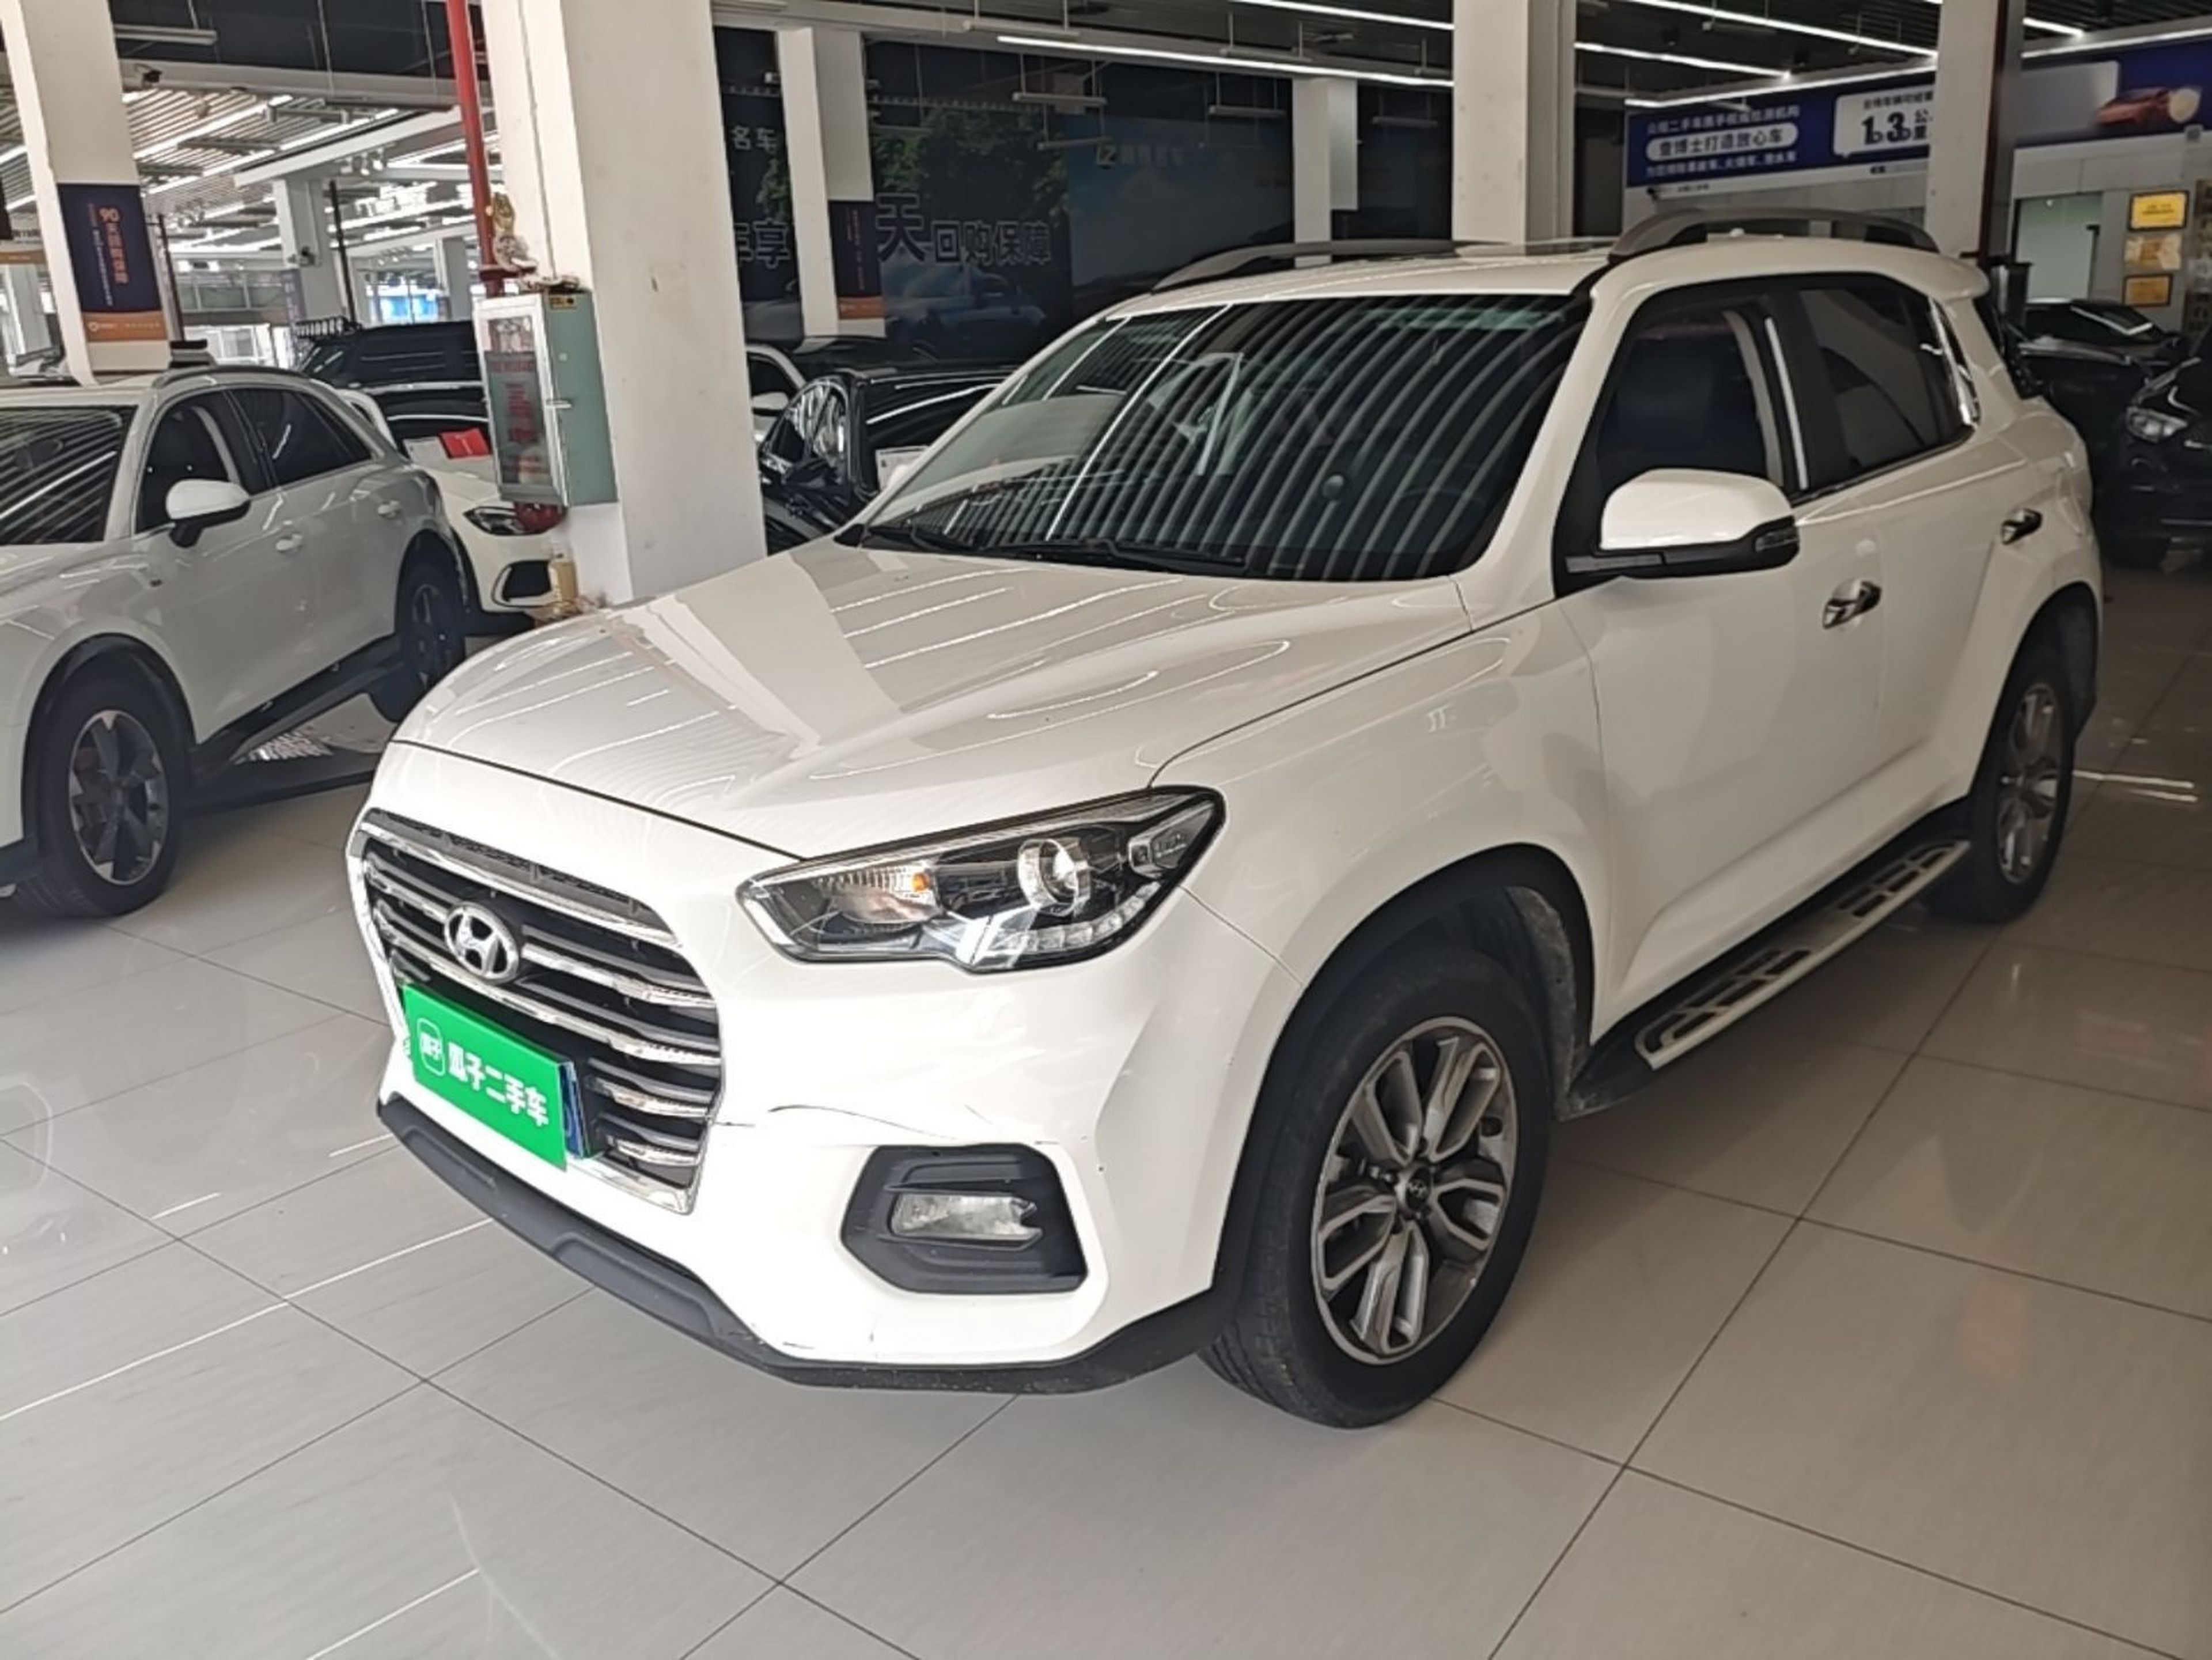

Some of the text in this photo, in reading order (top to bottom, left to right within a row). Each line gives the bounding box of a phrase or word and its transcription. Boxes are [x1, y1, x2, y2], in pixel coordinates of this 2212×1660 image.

[448, 1041, 550, 1128] 瓜子二手车
